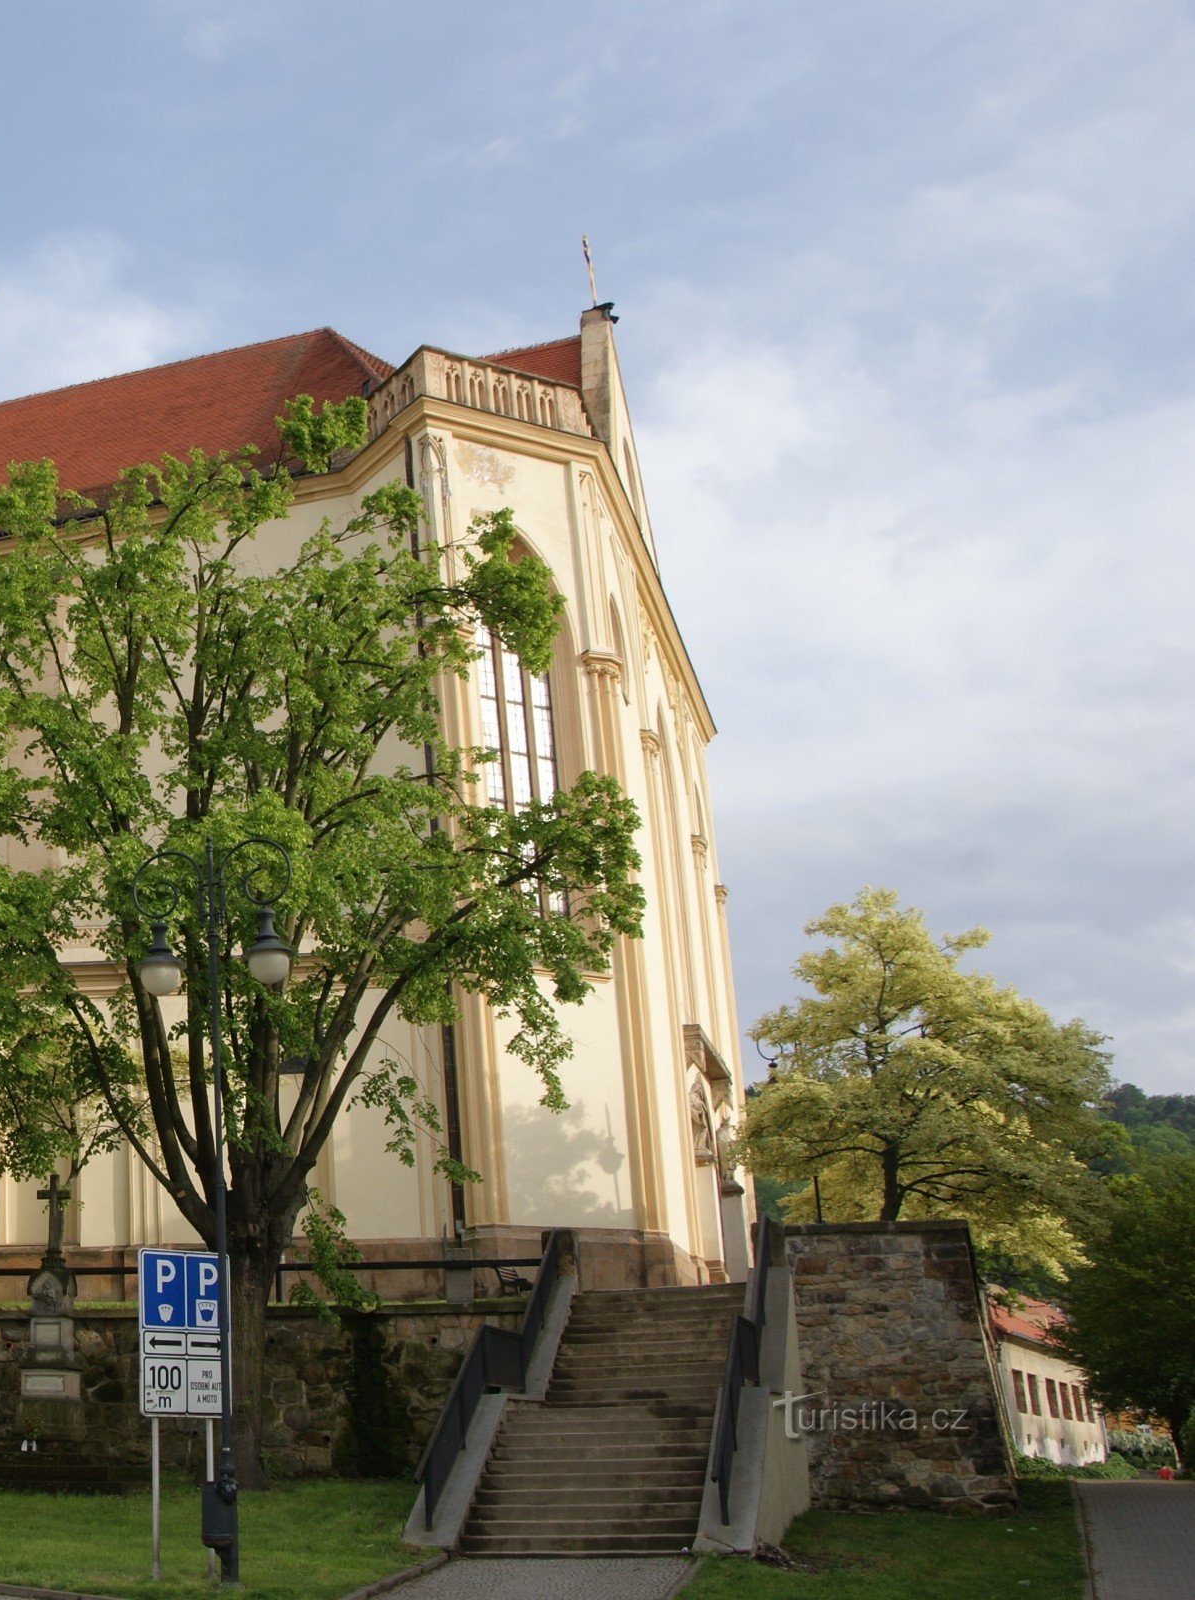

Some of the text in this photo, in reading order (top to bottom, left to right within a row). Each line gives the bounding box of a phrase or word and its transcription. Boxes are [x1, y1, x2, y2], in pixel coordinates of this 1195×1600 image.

[156, 1259, 176, 1293] P
[199, 1262, 218, 1296] P
[149, 1365, 181, 1390] 100
[202, 1370, 213, 1379] PRO
[190, 1380, 210, 1391] OSOBNÍ
[158, 1395, 172, 1408] m
[196, 1394, 217, 1403] A MOTO
